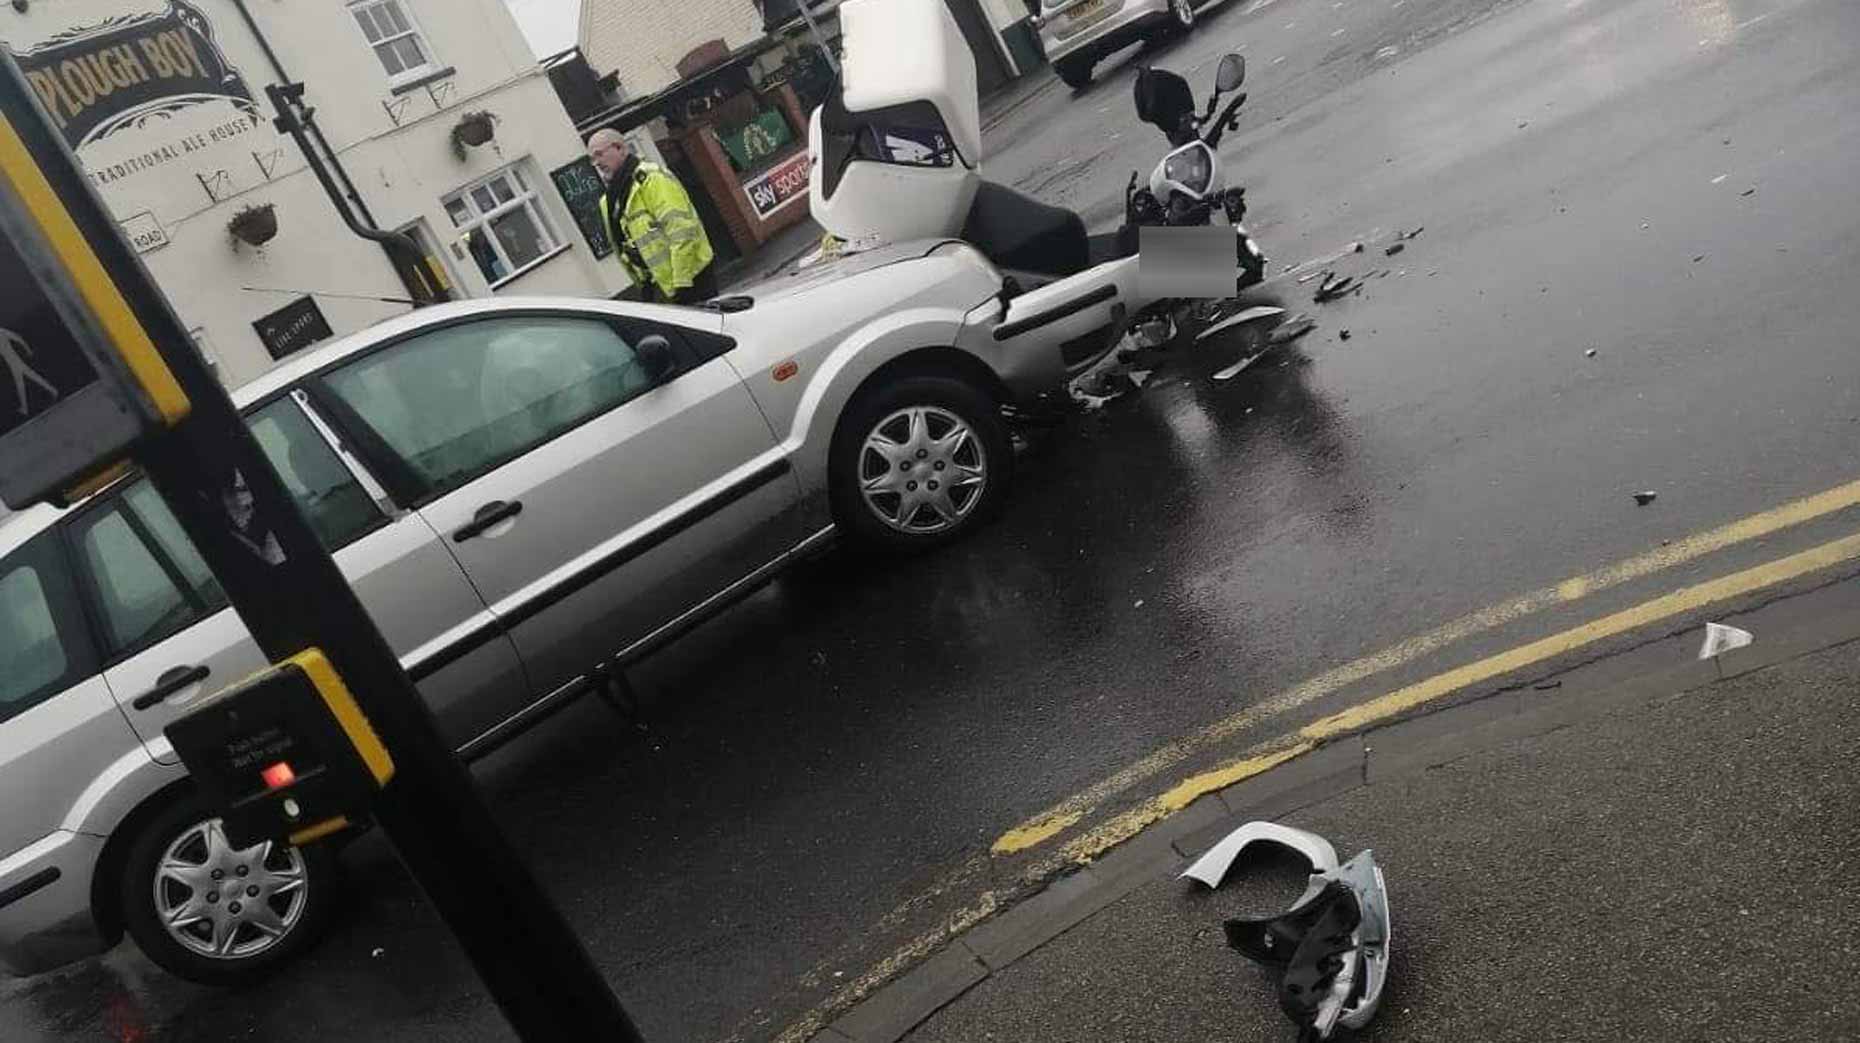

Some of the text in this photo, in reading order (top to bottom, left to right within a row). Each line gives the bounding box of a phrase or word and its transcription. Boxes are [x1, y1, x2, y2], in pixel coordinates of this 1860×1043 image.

[25, 26, 209, 129] PLOUGH BOY
[88, 117, 250, 187] TRADITIONAL ALE HOUSE
[753, 183, 776, 208] sky
[133, 229, 163, 247] ROAD
